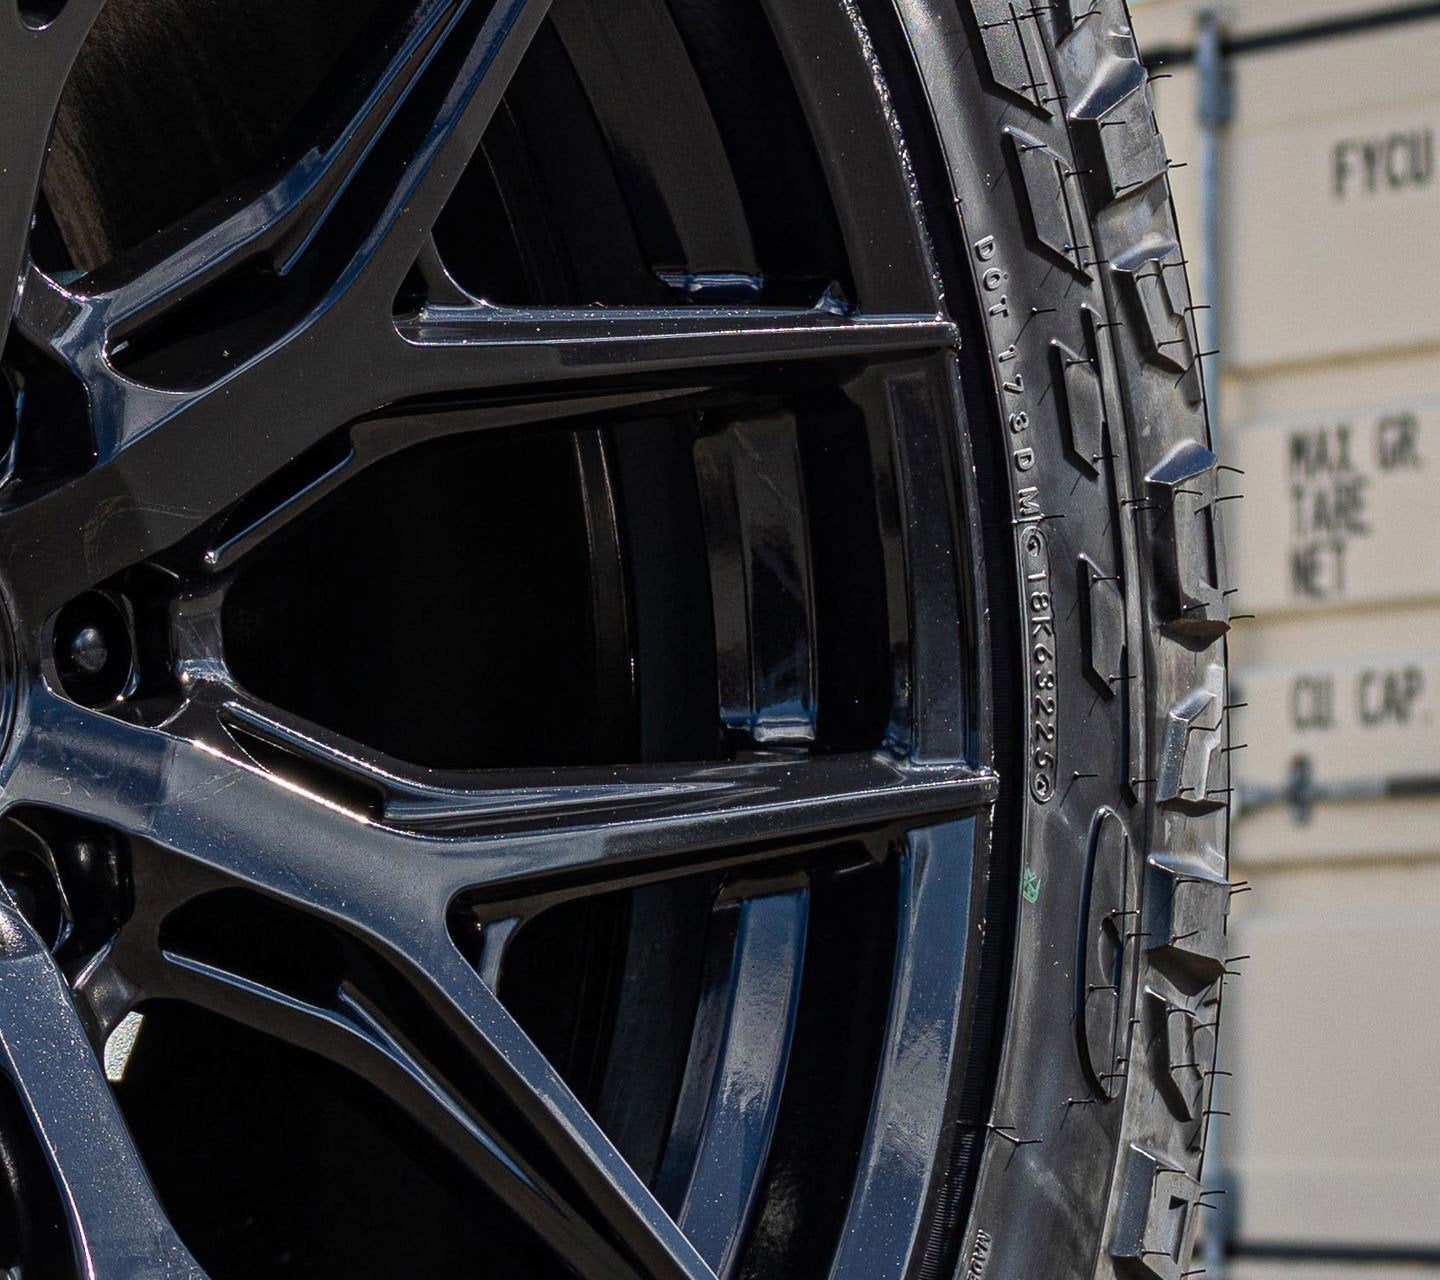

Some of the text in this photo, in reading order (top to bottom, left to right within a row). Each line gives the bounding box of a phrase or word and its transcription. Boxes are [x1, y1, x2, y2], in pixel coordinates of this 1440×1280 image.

[1330, 125, 1435, 202] FYCU
[974, 235, 1010, 319] DOT
[1290, 473, 1373, 540] TARE
[1289, 535, 1347, 600] NET
